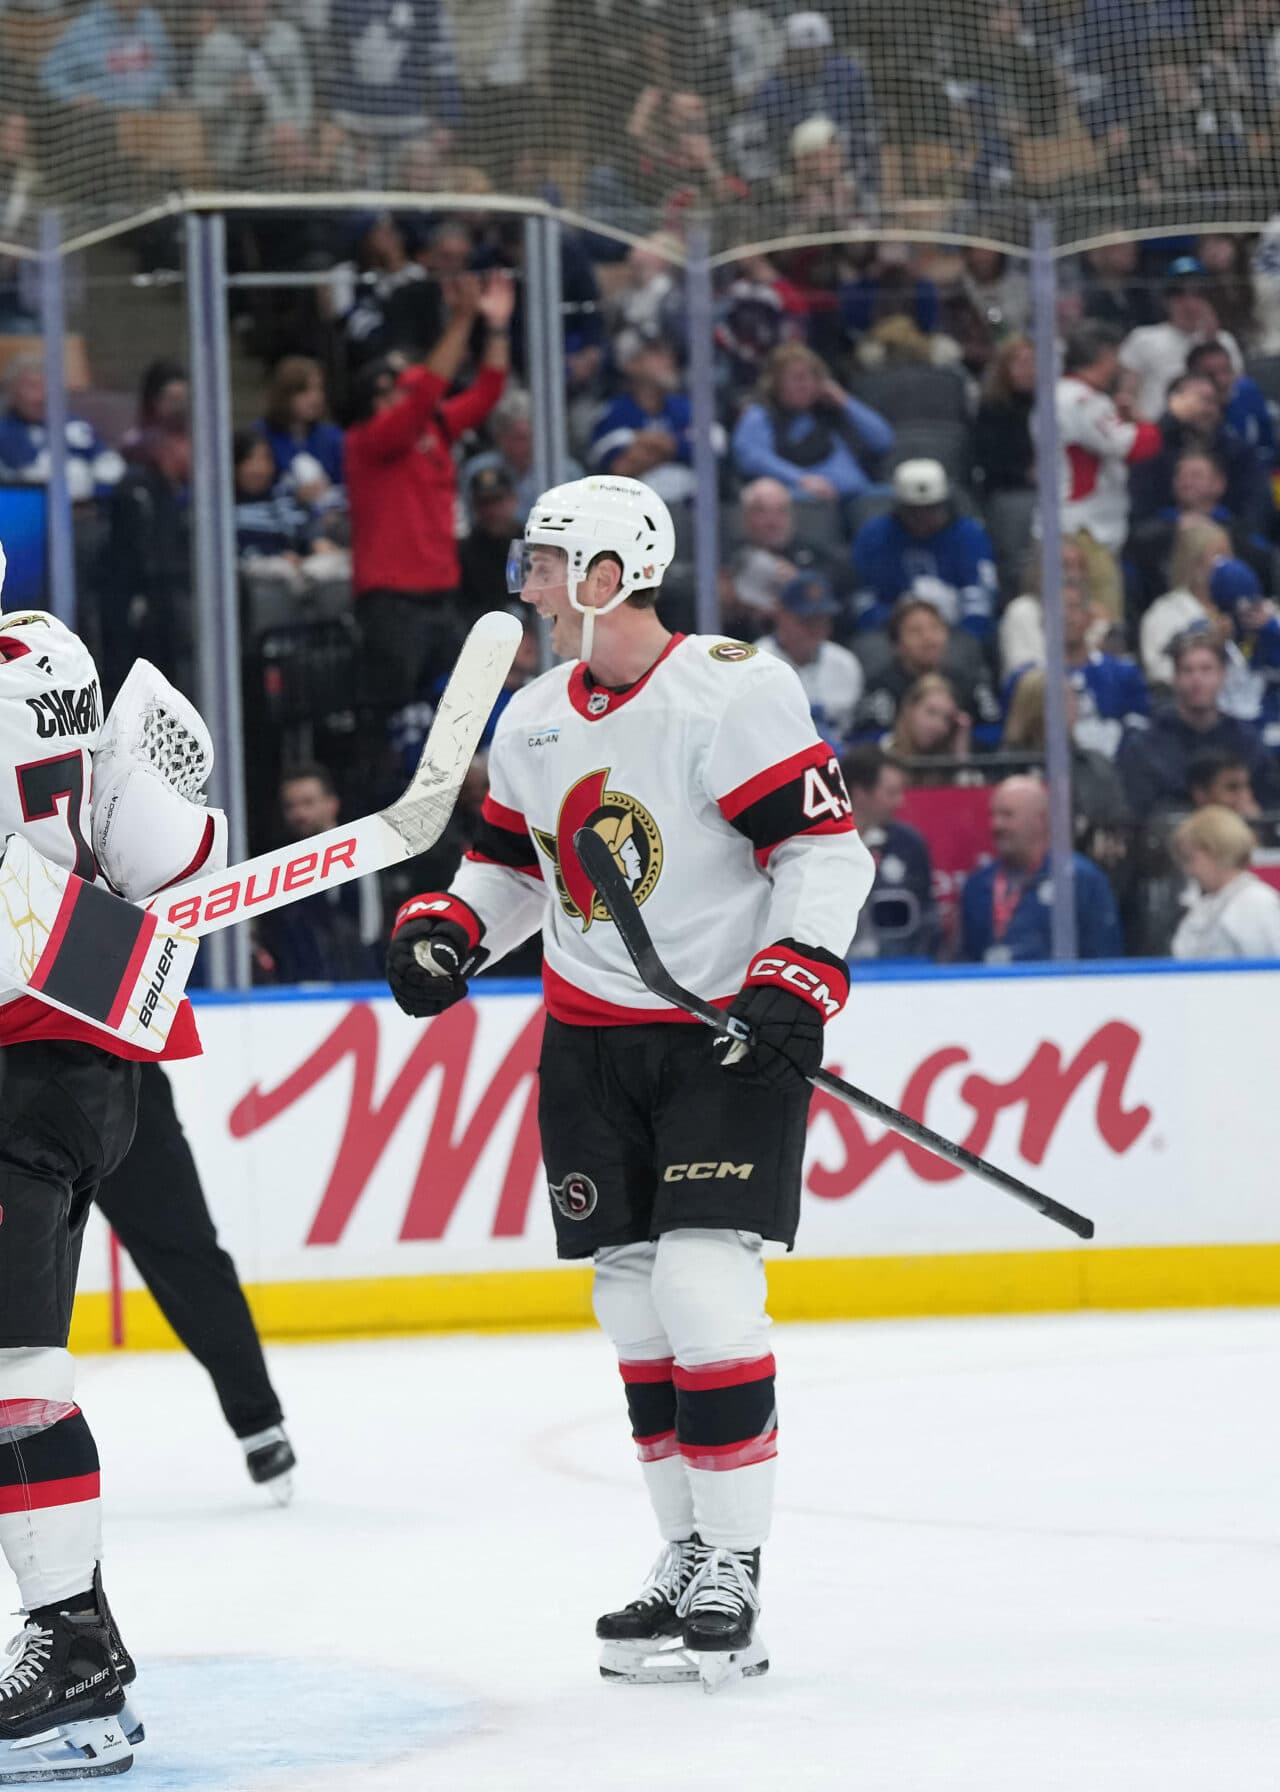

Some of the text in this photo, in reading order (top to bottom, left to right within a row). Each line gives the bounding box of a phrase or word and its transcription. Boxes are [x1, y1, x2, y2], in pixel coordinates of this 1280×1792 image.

[15, 748, 97, 884] 7
[168, 838, 357, 929] BAUER
[138, 936, 178, 1029] BAUER
[749, 957, 842, 1017] CCM
[664, 1161, 754, 1183] CCM
[65, 1667, 110, 1700] BAUER
